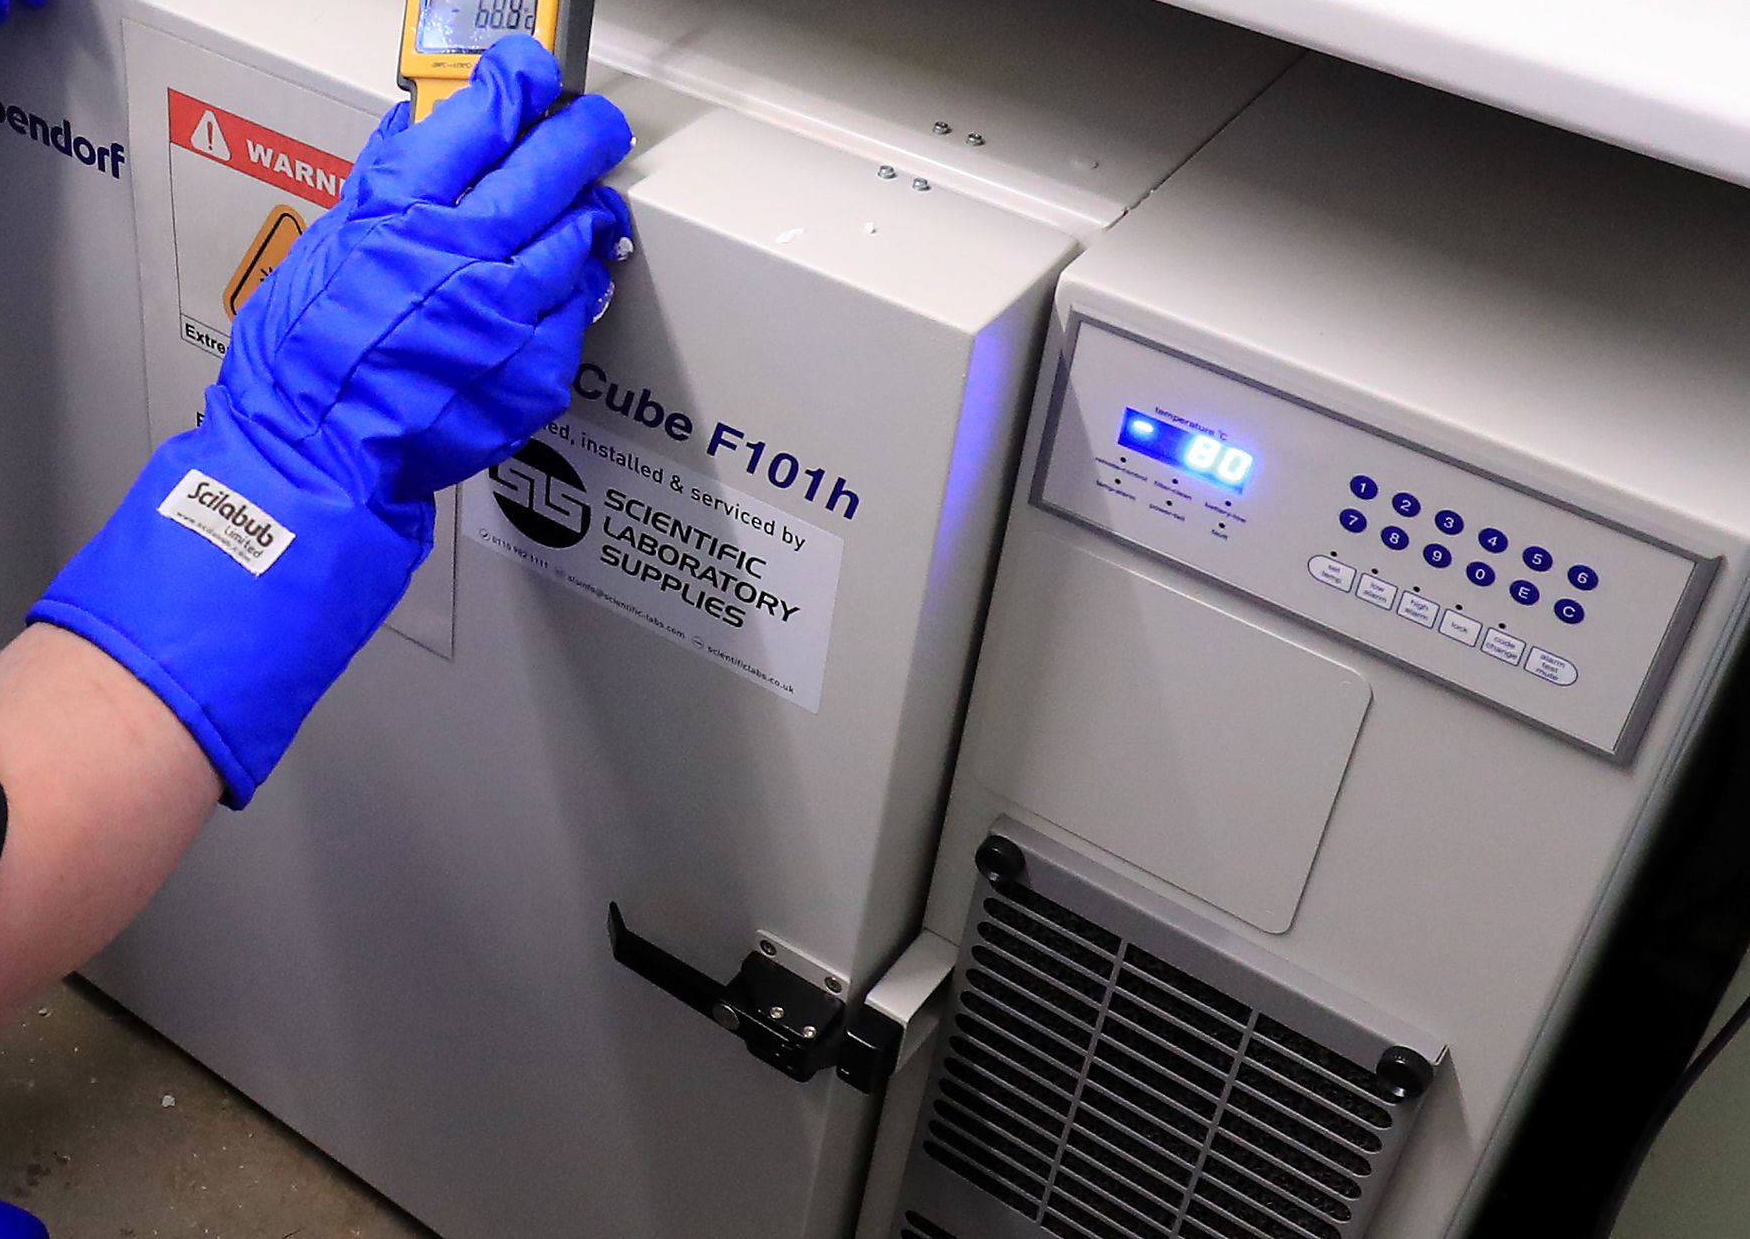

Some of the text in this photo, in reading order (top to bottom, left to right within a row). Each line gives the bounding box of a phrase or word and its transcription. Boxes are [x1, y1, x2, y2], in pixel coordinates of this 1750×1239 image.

[184, 322, 230, 356] Extre
[1155, 406, 1215, 437] temperature
[187, 481, 274, 548] Scilabub
[581, 431, 664, 484] installed
[670, 475, 685, 494] &
[690, 486, 775, 536] serviced
[782, 525, 807, 552] by
[706, 422, 860, 520] F101h
[224, 525, 264, 559] Limited
[603, 516, 801, 623] LABORATORY
[604, 488, 768, 580] SCIENTIFIC
[1348, 515, 1358, 525] 7
[1390, 533, 1400, 544] 8
[1432, 551, 1442, 562] 9
[1518, 587, 1530, 598] E
[1563, 607, 1575, 618] C
[1360, 482, 1588, 584] 1 2 3 4 5 6
[600, 544, 747, 629] SUPPLIES
